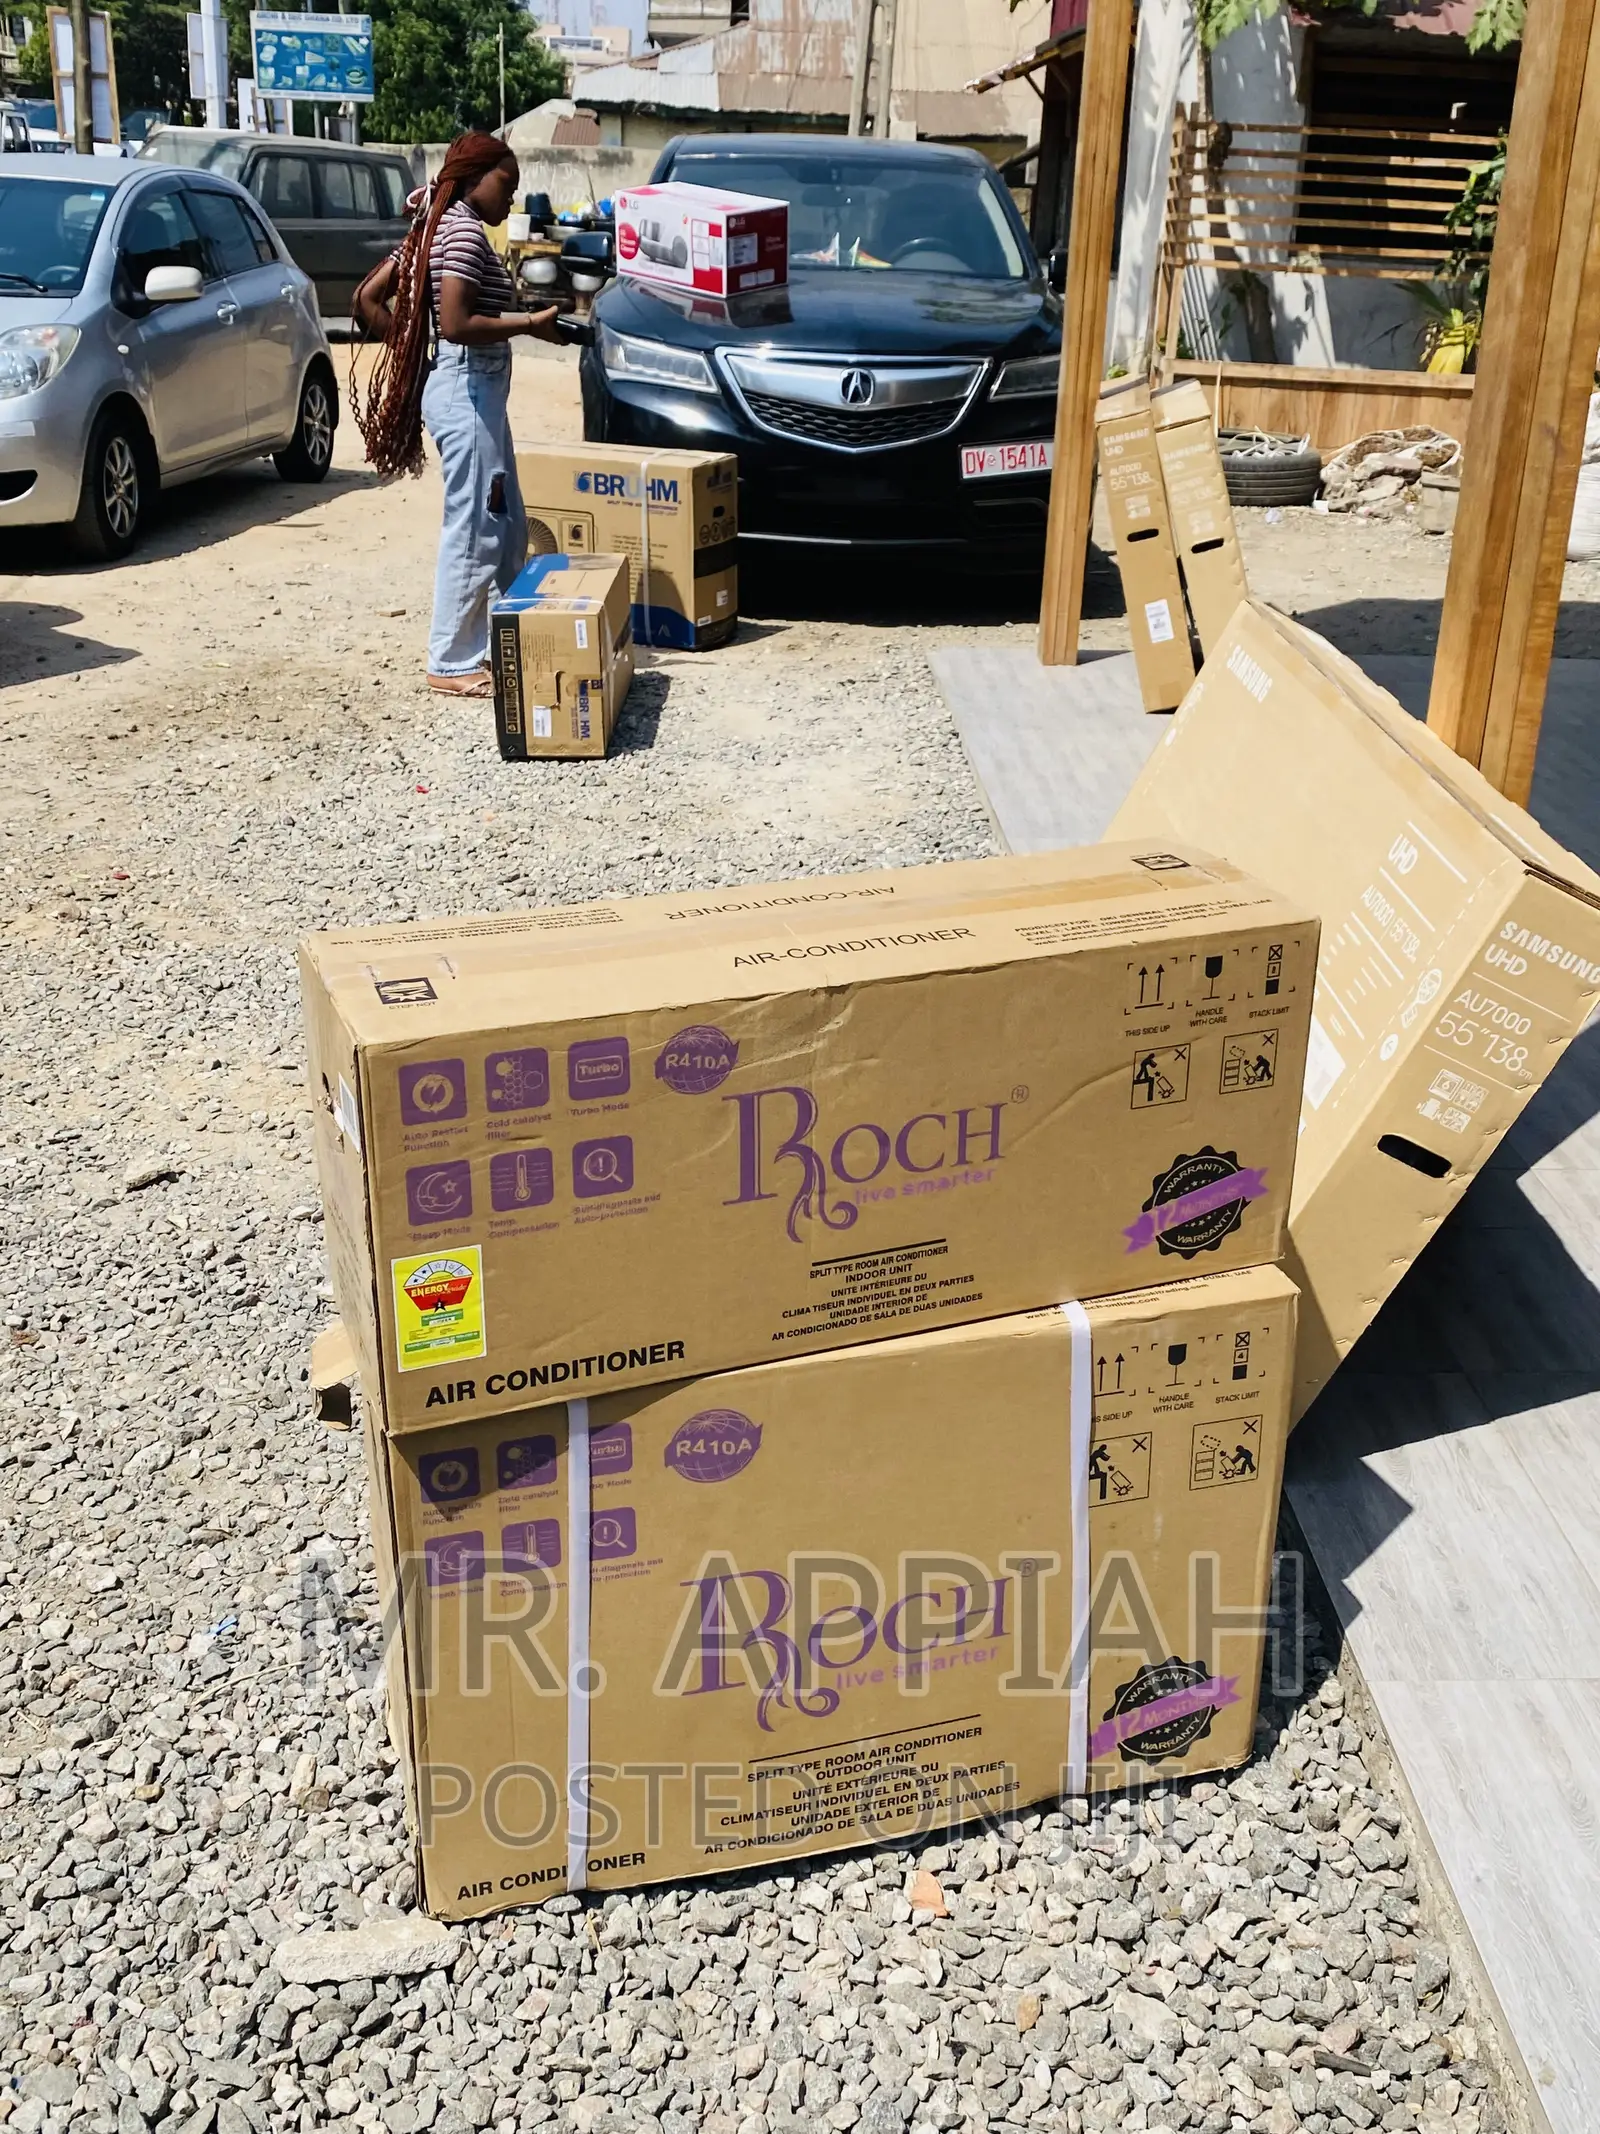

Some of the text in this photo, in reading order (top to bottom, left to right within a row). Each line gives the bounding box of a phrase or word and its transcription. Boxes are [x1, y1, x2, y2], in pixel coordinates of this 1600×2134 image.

[629, 200, 639, 210] LG
[1103, 428, 1149, 445] SAMSUNG
[966, 444, 1047, 474] DV 1541A
[1227, 644, 1273, 704] SAMSUNG
[1388, 834, 1418, 874] UHD
[664, 886, 895, 921] AIR-CONDITIONER
[734, 928, 977, 968] AIR-CONDITIONER
[1484, 944, 1528, 976] UHD
[1500, 921, 1600, 984] SAMSUNG
[1190, 1016, 1228, 1027] WITH CARE
[1195, 1007, 1224, 1017] HANDLE
[1249, 1006, 1290, 1018] STACK LIMIT
[1454, 989, 1532, 1036] AU7000
[1125, 1024, 1170, 1037] THIS SIDE UP
[579, 1062, 619, 1076] Turbo
[664, 1050, 731, 1070] R410A
[486, 1118, 510, 1129] Cold
[570, 1102, 630, 1116] Turbo Mode
[854, 1168, 996, 1205] live smarter
[1164, 1162, 1226, 1194] WARRANTY
[1176, 1209, 1232, 1244] WARRANTY
[810, 1246, 948, 1278] SPLIT TYPE ROOM AIR CONDITIONER
[846, 1264, 913, 1283] INDOOR UNIT
[914, 1272, 928, 1282] DU
[411, 1283, 449, 1298] ENERGY
[847, 1290, 897, 1306] INDIVIDUEL
[899, 1286, 912, 1296] EN
[914, 1282, 937, 1293] DEUX
[939, 1274, 974, 1288] PARTIES
[772, 1292, 983, 1341] AR CONDICIONADO DE SALA DE DUAS UNIDADES
[830, 1293, 928, 1319] UNIDADE INTERIOR DE
[1024, 1312, 1049, 1320] web:
[426, 1380, 476, 1408] AIR
[486, 1340, 686, 1396] CONDITIONER
[1152, 1401, 1194, 1414] WITH CARE
[1158, 1393, 1190, 1404] HANDLE
[1215, 1390, 1260, 1404] STACK LIMIT
[1103, 1410, 1133, 1422] SIDE UP
[676, 1438, 753, 1458] R410A
[836, 1646, 998, 1690] live smarter
[1128, 1672, 1194, 1702] WARRANTY
[1140, 1716, 1200, 1750] WARRANTY
[748, 1727, 982, 1782] SPLIT TYPE ROOM AIR CONDITIONER
[816, 1752, 916, 1780] OUTDOOR UNIT
[720, 1760, 1006, 1826] CLIMATISEUR INDIVIDUEL EN DEUX PARTIES
[792, 1762, 939, 1800] UNITÉ EXTÉRIEURE DU
[704, 1781, 1020, 1855] AR CONDICIONADO DE SALA DE DUAS UNIDADES
[791, 1788, 940, 1826] UNIDADE EXTERIOR DE
[457, 1852, 646, 1900] AIR CONDIONER
